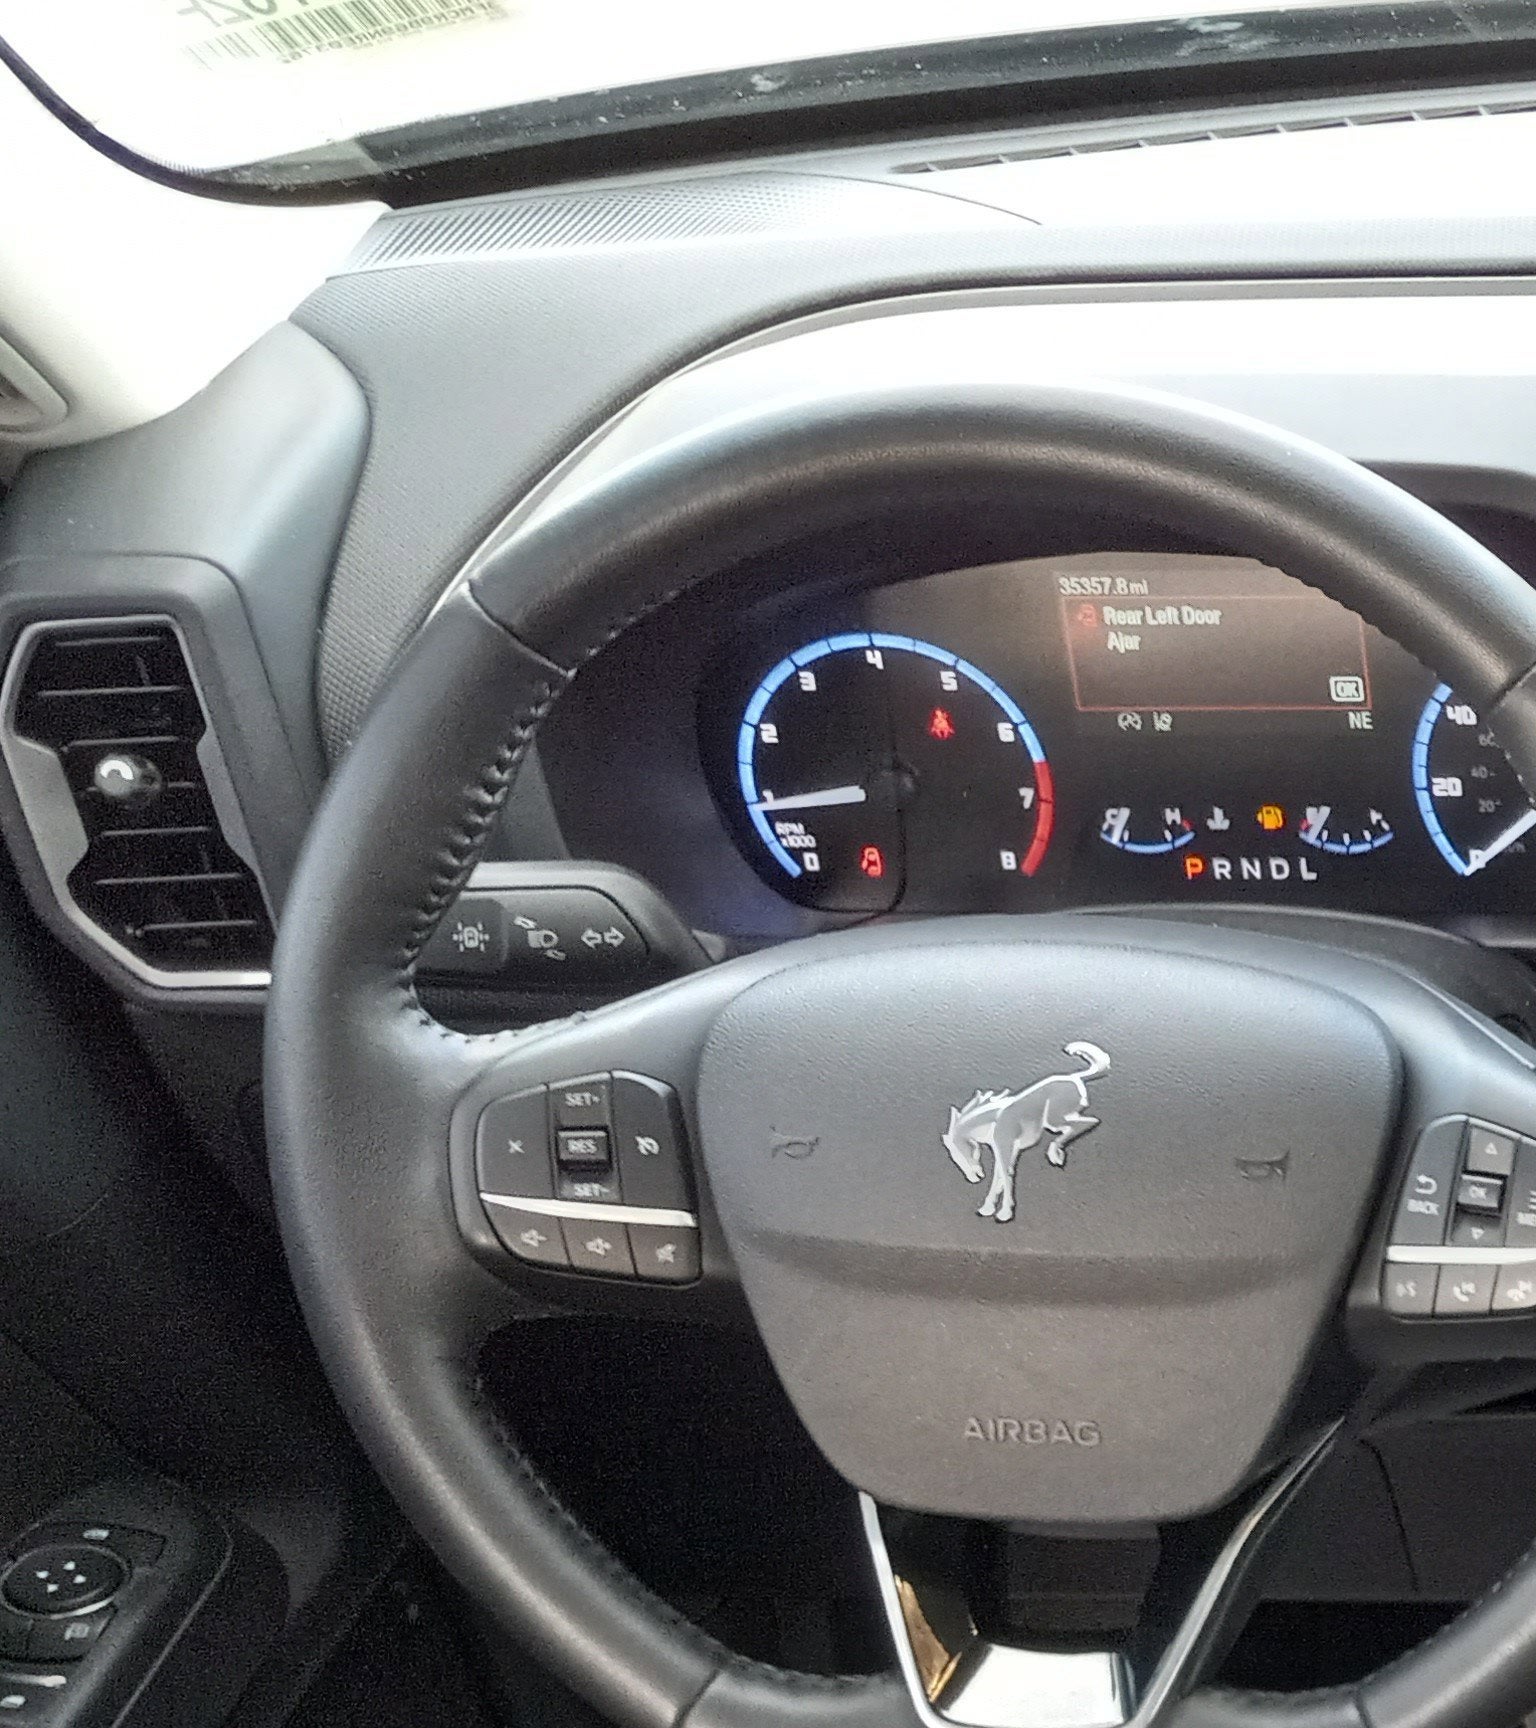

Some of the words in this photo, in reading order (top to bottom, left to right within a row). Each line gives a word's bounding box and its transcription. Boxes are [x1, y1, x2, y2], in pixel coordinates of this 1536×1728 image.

[1102, 605, 1144, 626] Rear
[1145, 605, 1180, 626] Left
[1181, 605, 1223, 626] Door
[1106, 631, 1141, 654] Ajar
[865, 650, 884, 670] 4
[798, 670, 817, 692] 3
[939, 670, 958, 692] 5
[1349, 711, 1374, 730] NE
[1446, 704, 1477, 726] 40
[759, 722, 779, 744] 2
[998, 722, 1015, 742] 6
[1431, 776, 1463, 797] 20
[1019, 787, 1034, 809] 7
[803, 851, 821, 872] 0
[1000, 850, 1017, 871] 8
[1185, 858, 1204, 880] P
[1213, 857, 1234, 880] R
[1240, 857, 1262, 880] N
[1270, 857, 1291, 880] D
[1299, 856, 1318, 881] L
[962, 1416, 1100, 1447] AIRBAG
